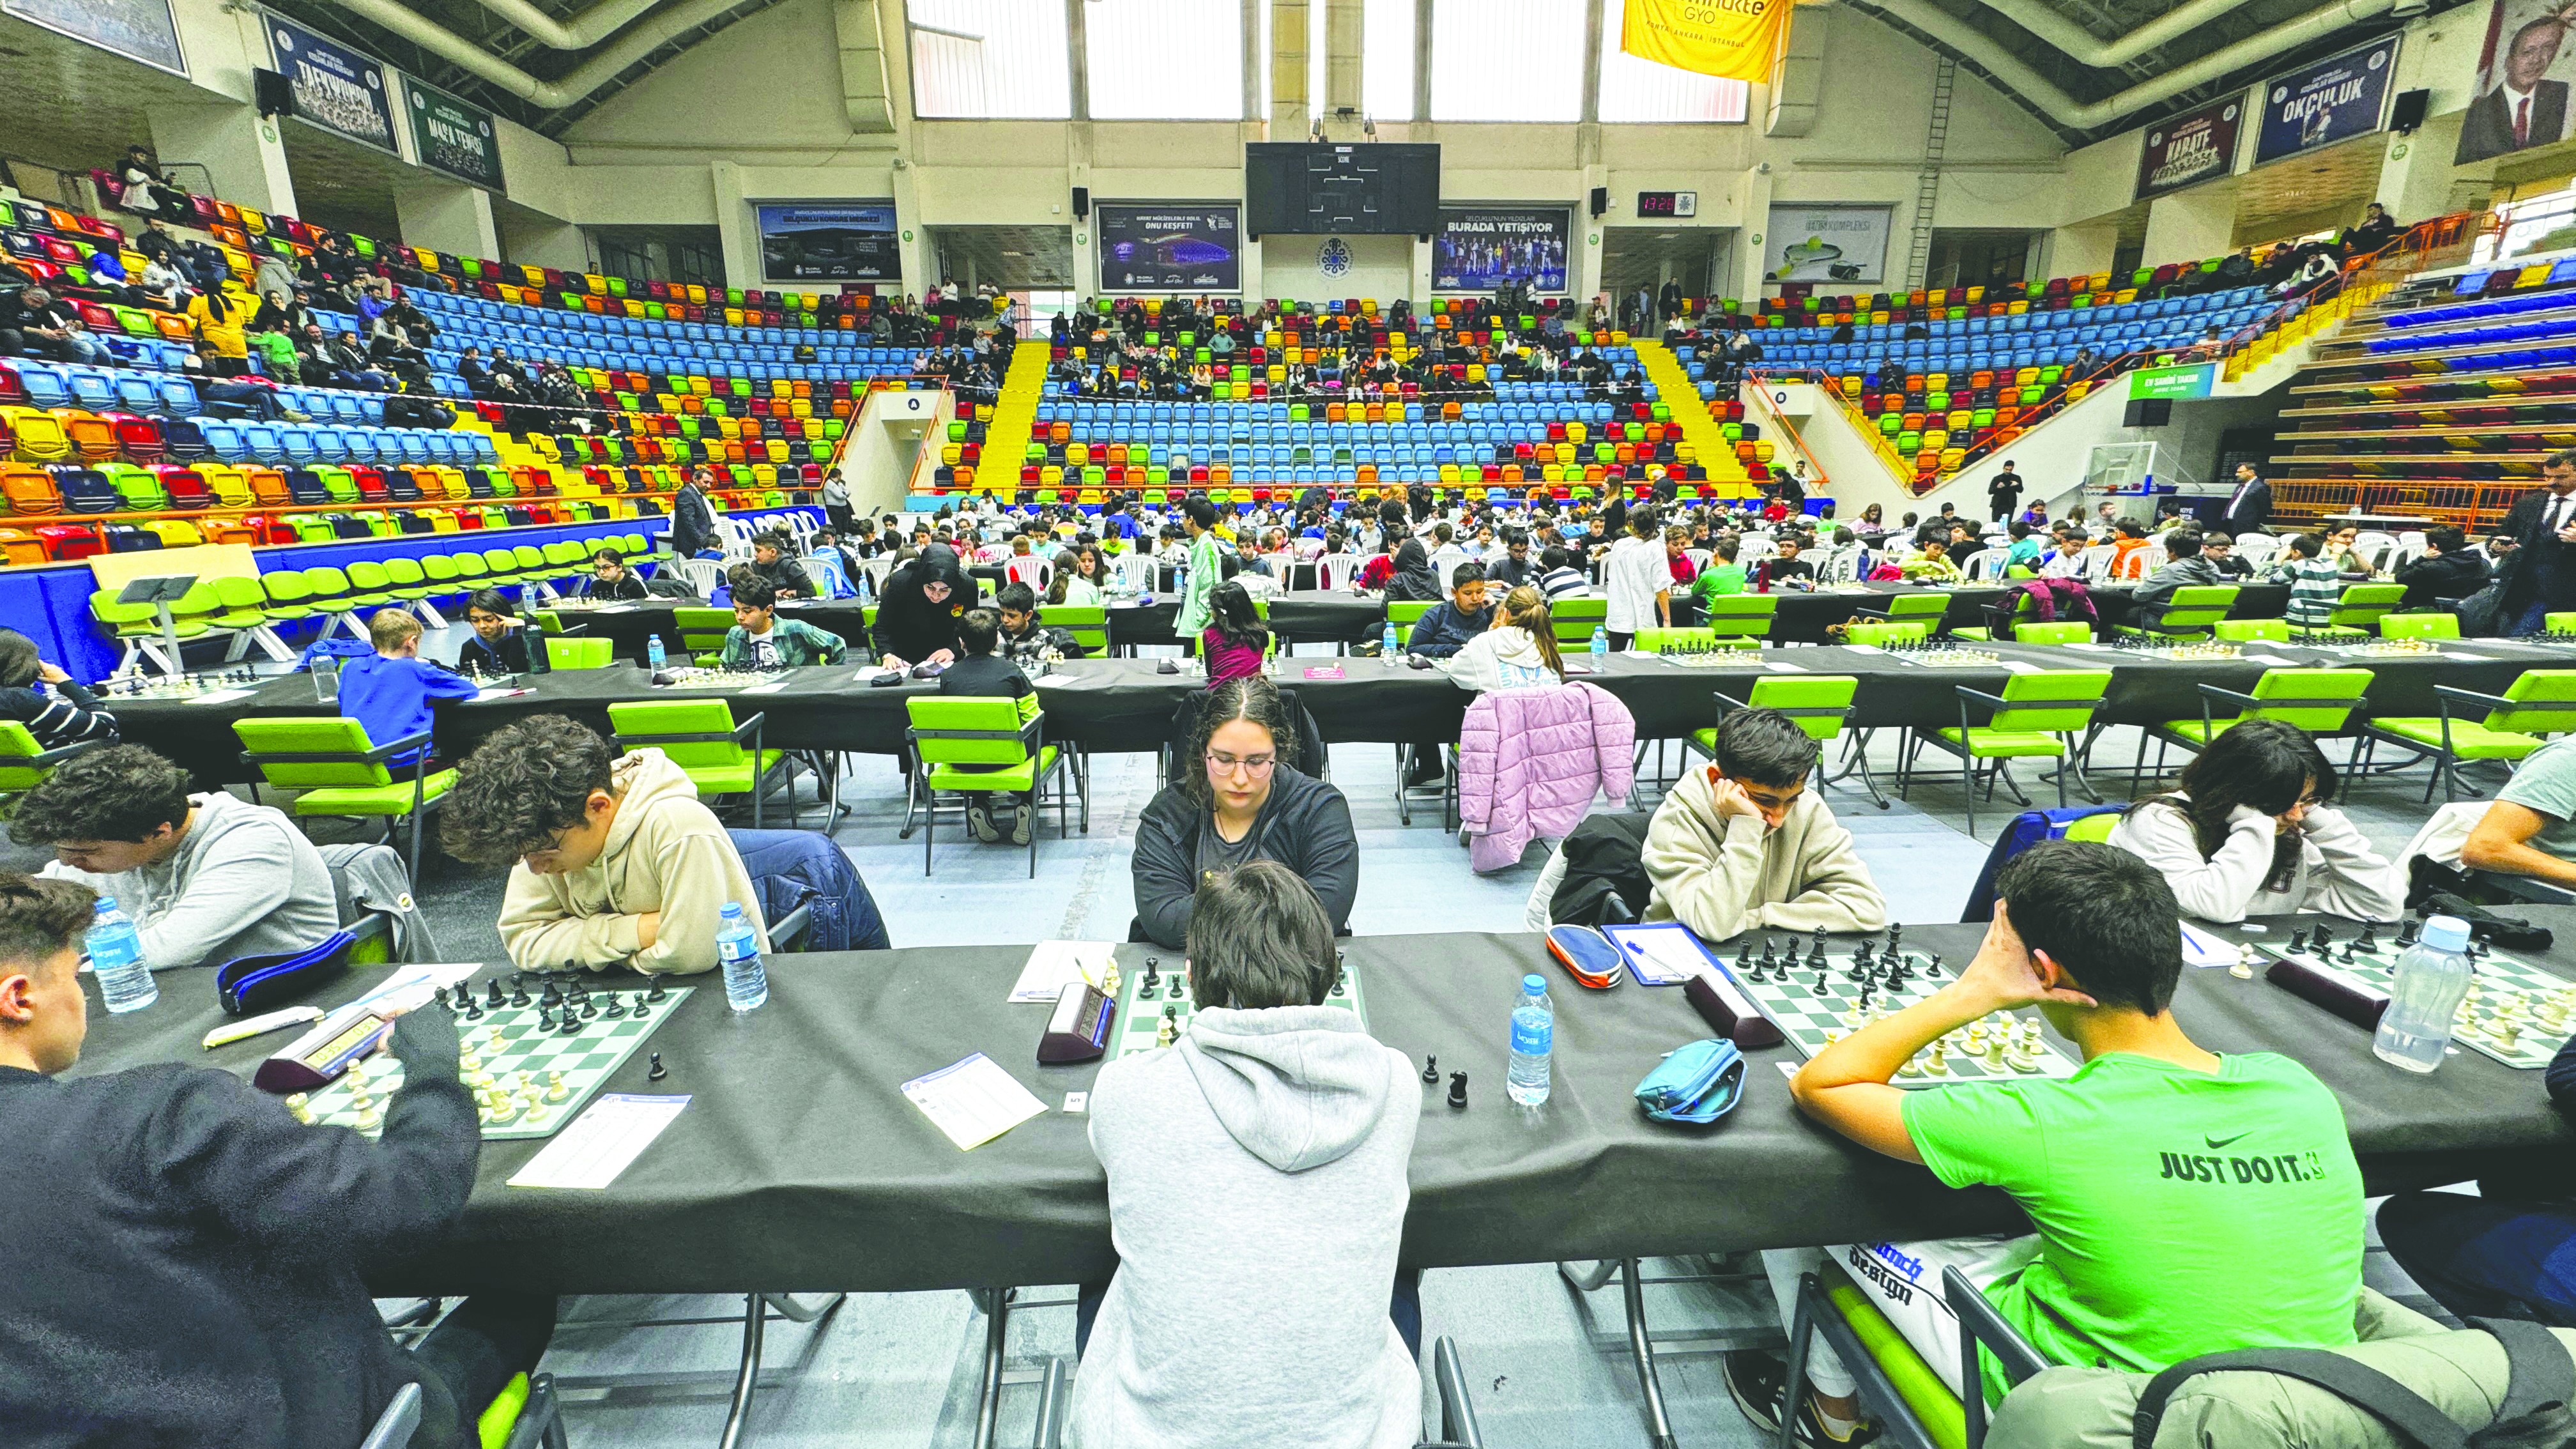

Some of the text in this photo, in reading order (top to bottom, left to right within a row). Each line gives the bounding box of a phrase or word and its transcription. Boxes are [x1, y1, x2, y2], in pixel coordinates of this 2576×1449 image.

[1685, 6, 1715, 24] GYO
[1646, 20, 1669, 32] KONYA
[1674, 29, 1703, 41] ANKARA
[2165, 128, 2212, 163] KARATE
[1448, 222, 1553, 234] BURADA YETİŞİYOR
[2159, 1151, 2310, 1184] JUST DO IT.
[1849, 1246, 1913, 1306] design
